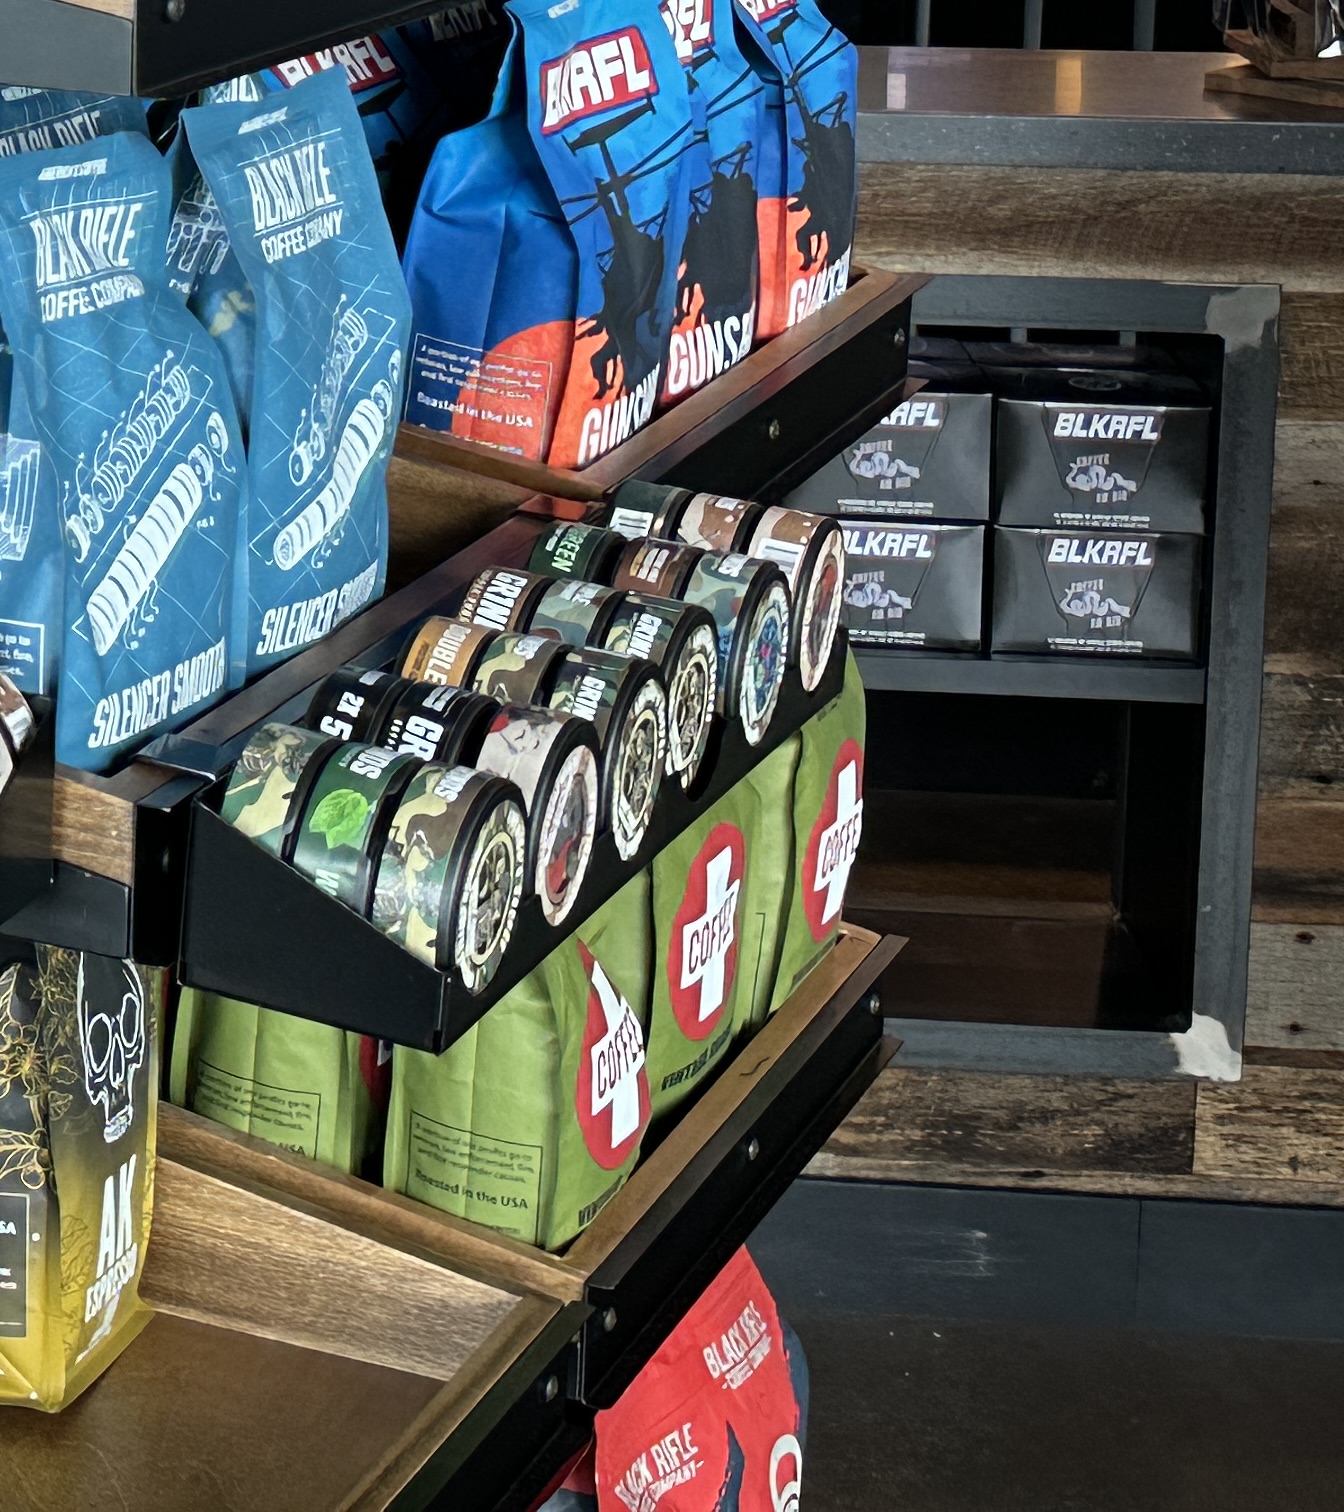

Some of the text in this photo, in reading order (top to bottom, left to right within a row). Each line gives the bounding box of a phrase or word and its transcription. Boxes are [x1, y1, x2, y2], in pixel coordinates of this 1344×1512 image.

[80, 203, 144, 270] RIFLE
[261, 226, 306, 264] COFFEE
[505, 411, 533, 428] USA
[256, 588, 338, 656] SILENCER
[87, 669, 171, 749] SILENCER
[95, 1154, 138, 1279] AK
[501, 1193, 528, 1210] USA
[84, 1243, 138, 1323] ESPRESSO
[650, 1422, 698, 1477] RIFLE
